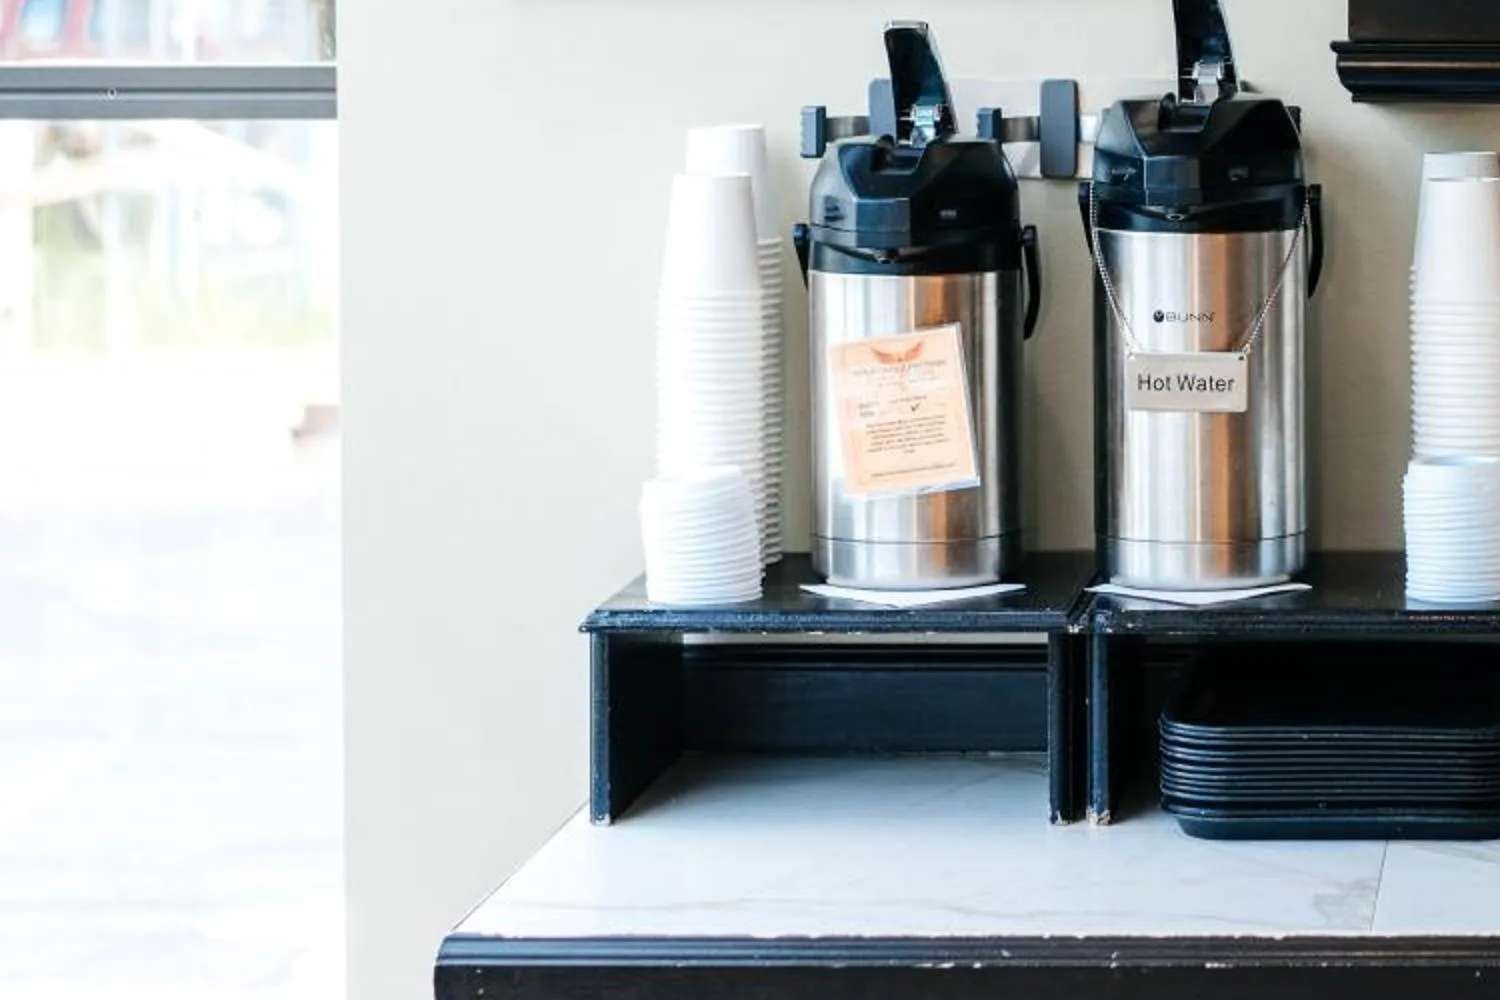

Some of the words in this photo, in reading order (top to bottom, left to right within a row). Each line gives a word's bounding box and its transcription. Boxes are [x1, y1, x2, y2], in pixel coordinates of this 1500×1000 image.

[1166, 312, 1215, 322] BUNN
[1137, 373, 1171, 391] Hot
[1177, 373, 1235, 392] Water
